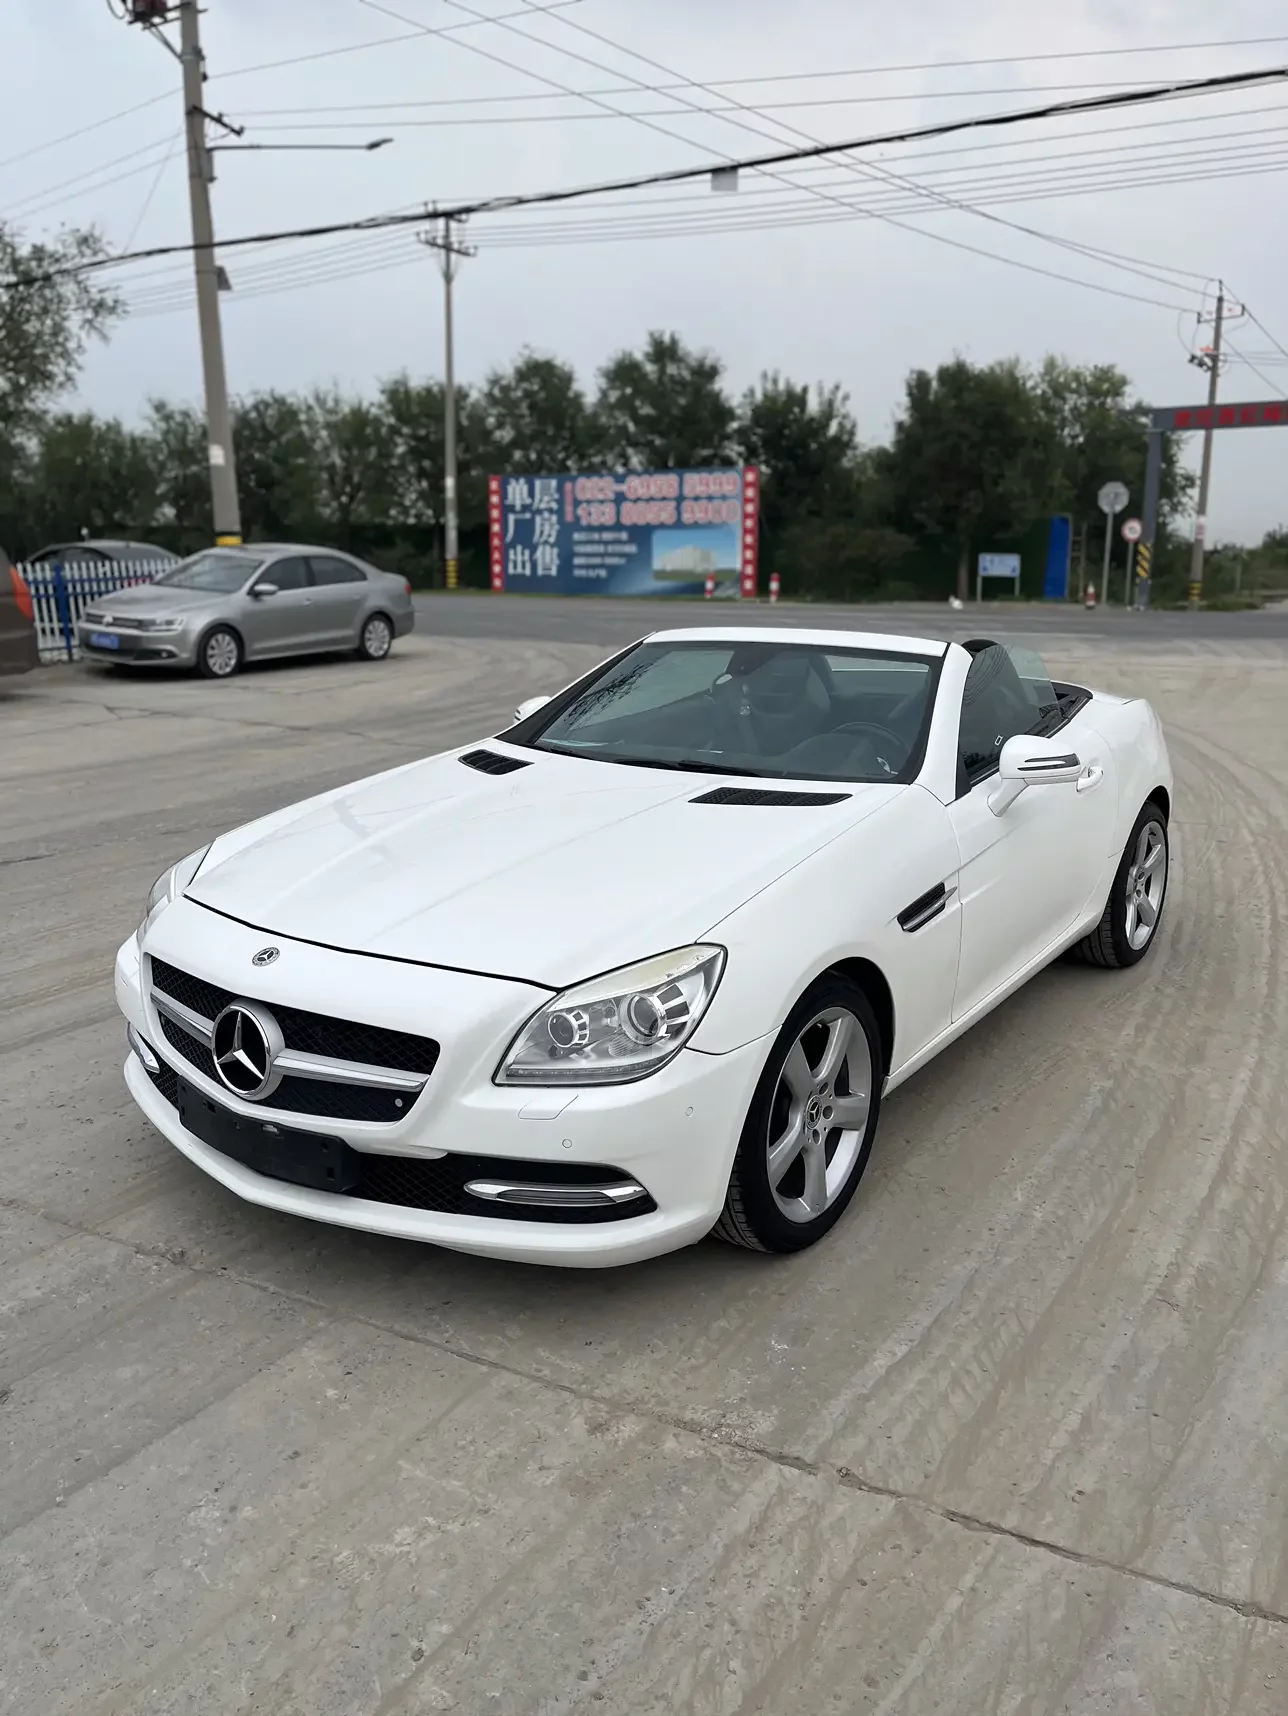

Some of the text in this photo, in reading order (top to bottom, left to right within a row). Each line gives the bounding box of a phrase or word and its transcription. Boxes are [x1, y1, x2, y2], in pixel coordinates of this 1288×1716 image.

[505, 477, 560, 511] 单层
[505, 511, 561, 544] 厂房
[507, 544, 560, 577] 出售
